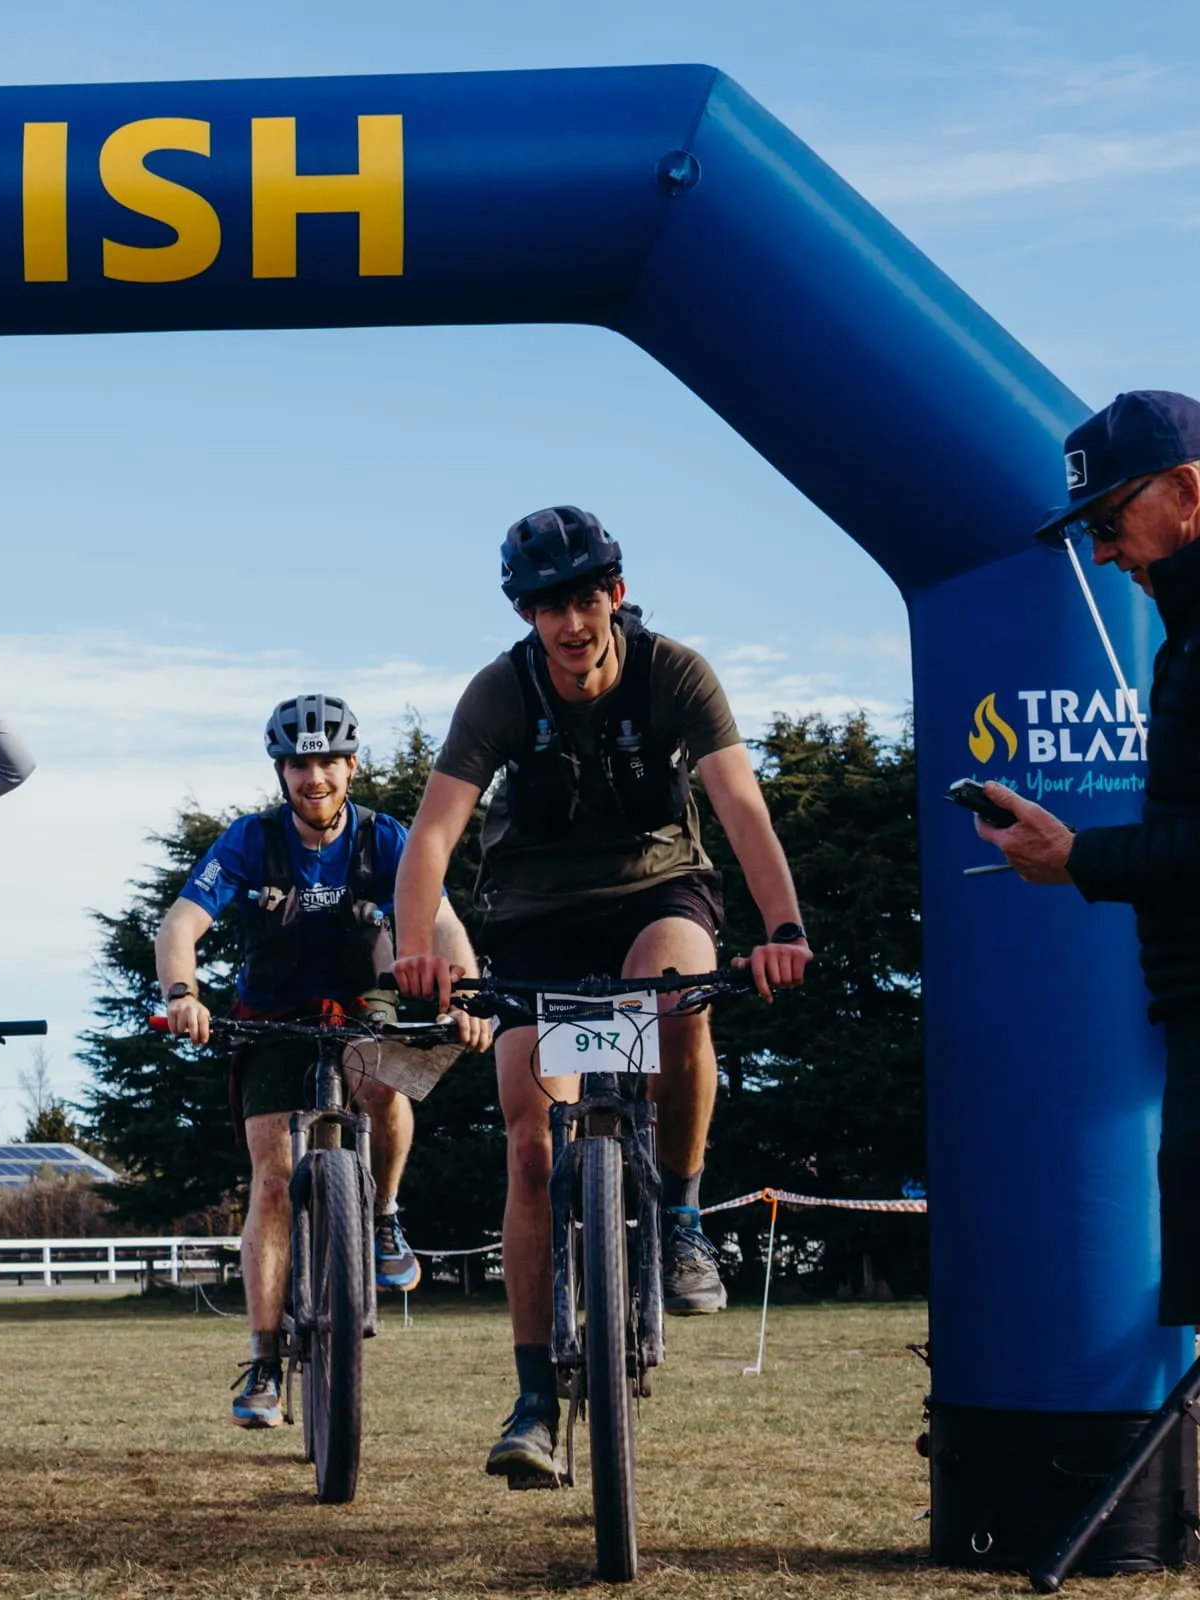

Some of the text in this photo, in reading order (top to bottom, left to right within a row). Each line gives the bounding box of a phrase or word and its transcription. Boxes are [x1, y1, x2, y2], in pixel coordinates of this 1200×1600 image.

[1018, 688, 1146, 724] TRAIL
[302, 740, 323, 751] 689
[1026, 768, 1074, 801] Your
[575, 1031, 621, 1053] 917
